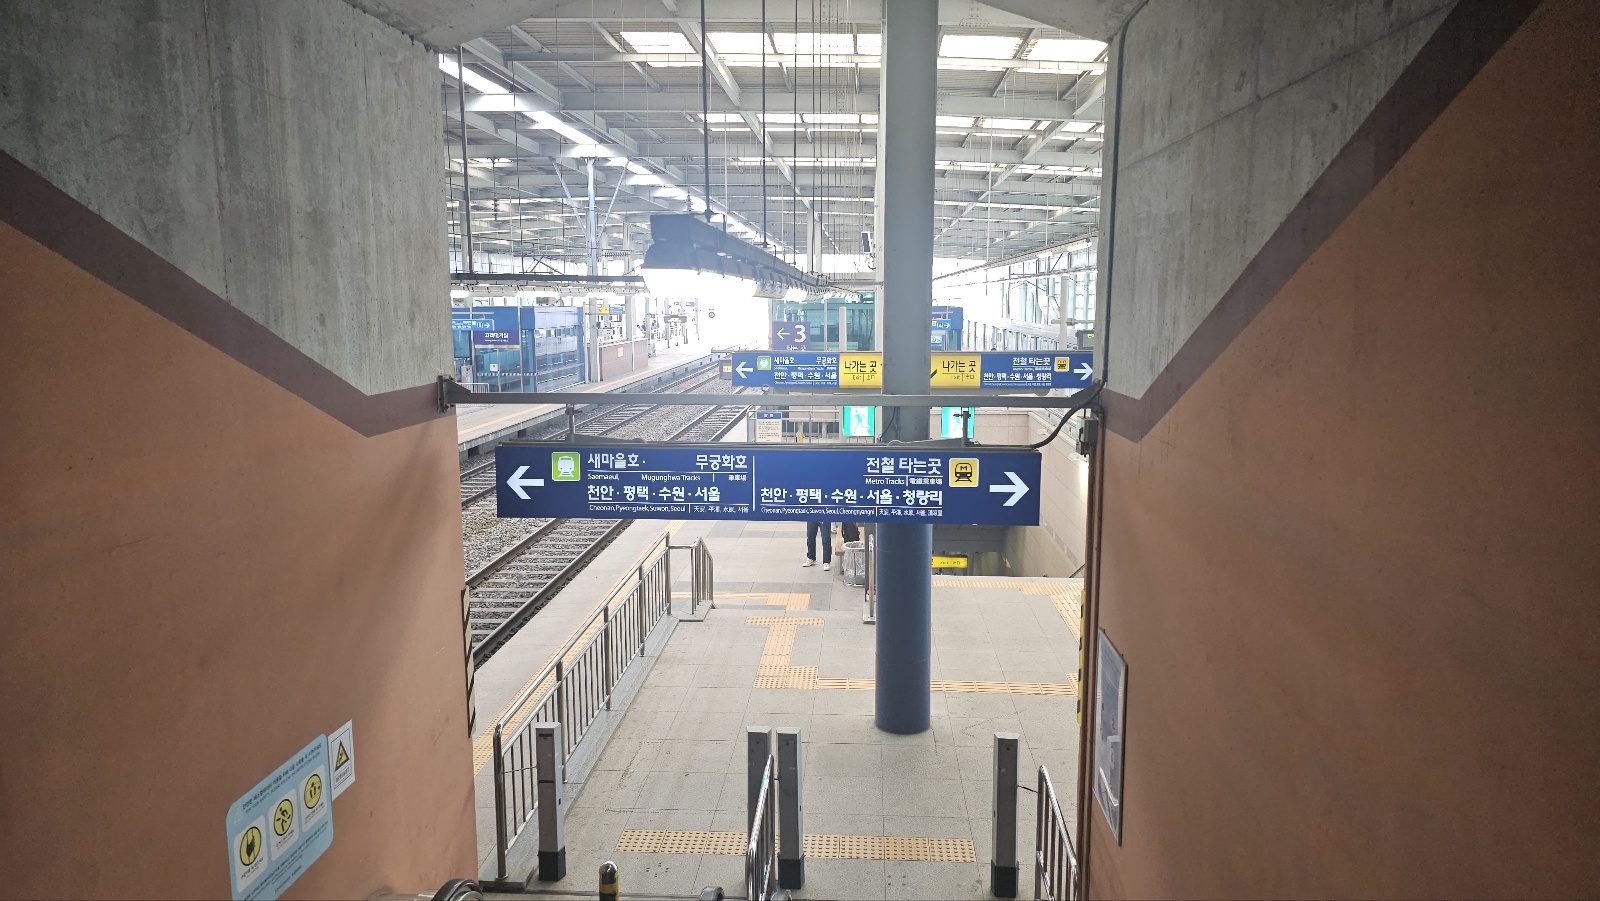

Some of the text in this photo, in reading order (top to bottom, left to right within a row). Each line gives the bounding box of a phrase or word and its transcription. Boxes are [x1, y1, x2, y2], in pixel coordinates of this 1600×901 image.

[794, 324, 806, 342] 3
[844, 361, 877, 373] 나가는 곳
[942, 361, 976, 372] 나가는 곳
[1012, 357, 1028, 366] 전철
[588, 453, 748, 470] 새마을호 무궁화호
[866, 457, 942, 474] 전철 타는곳
[642, 474, 680, 482] Mugunghwa
[588, 485, 720, 502] 천안 평택 수원 서울
[761, 488, 942, 506] 천안 평택 수원 서울 청량리
